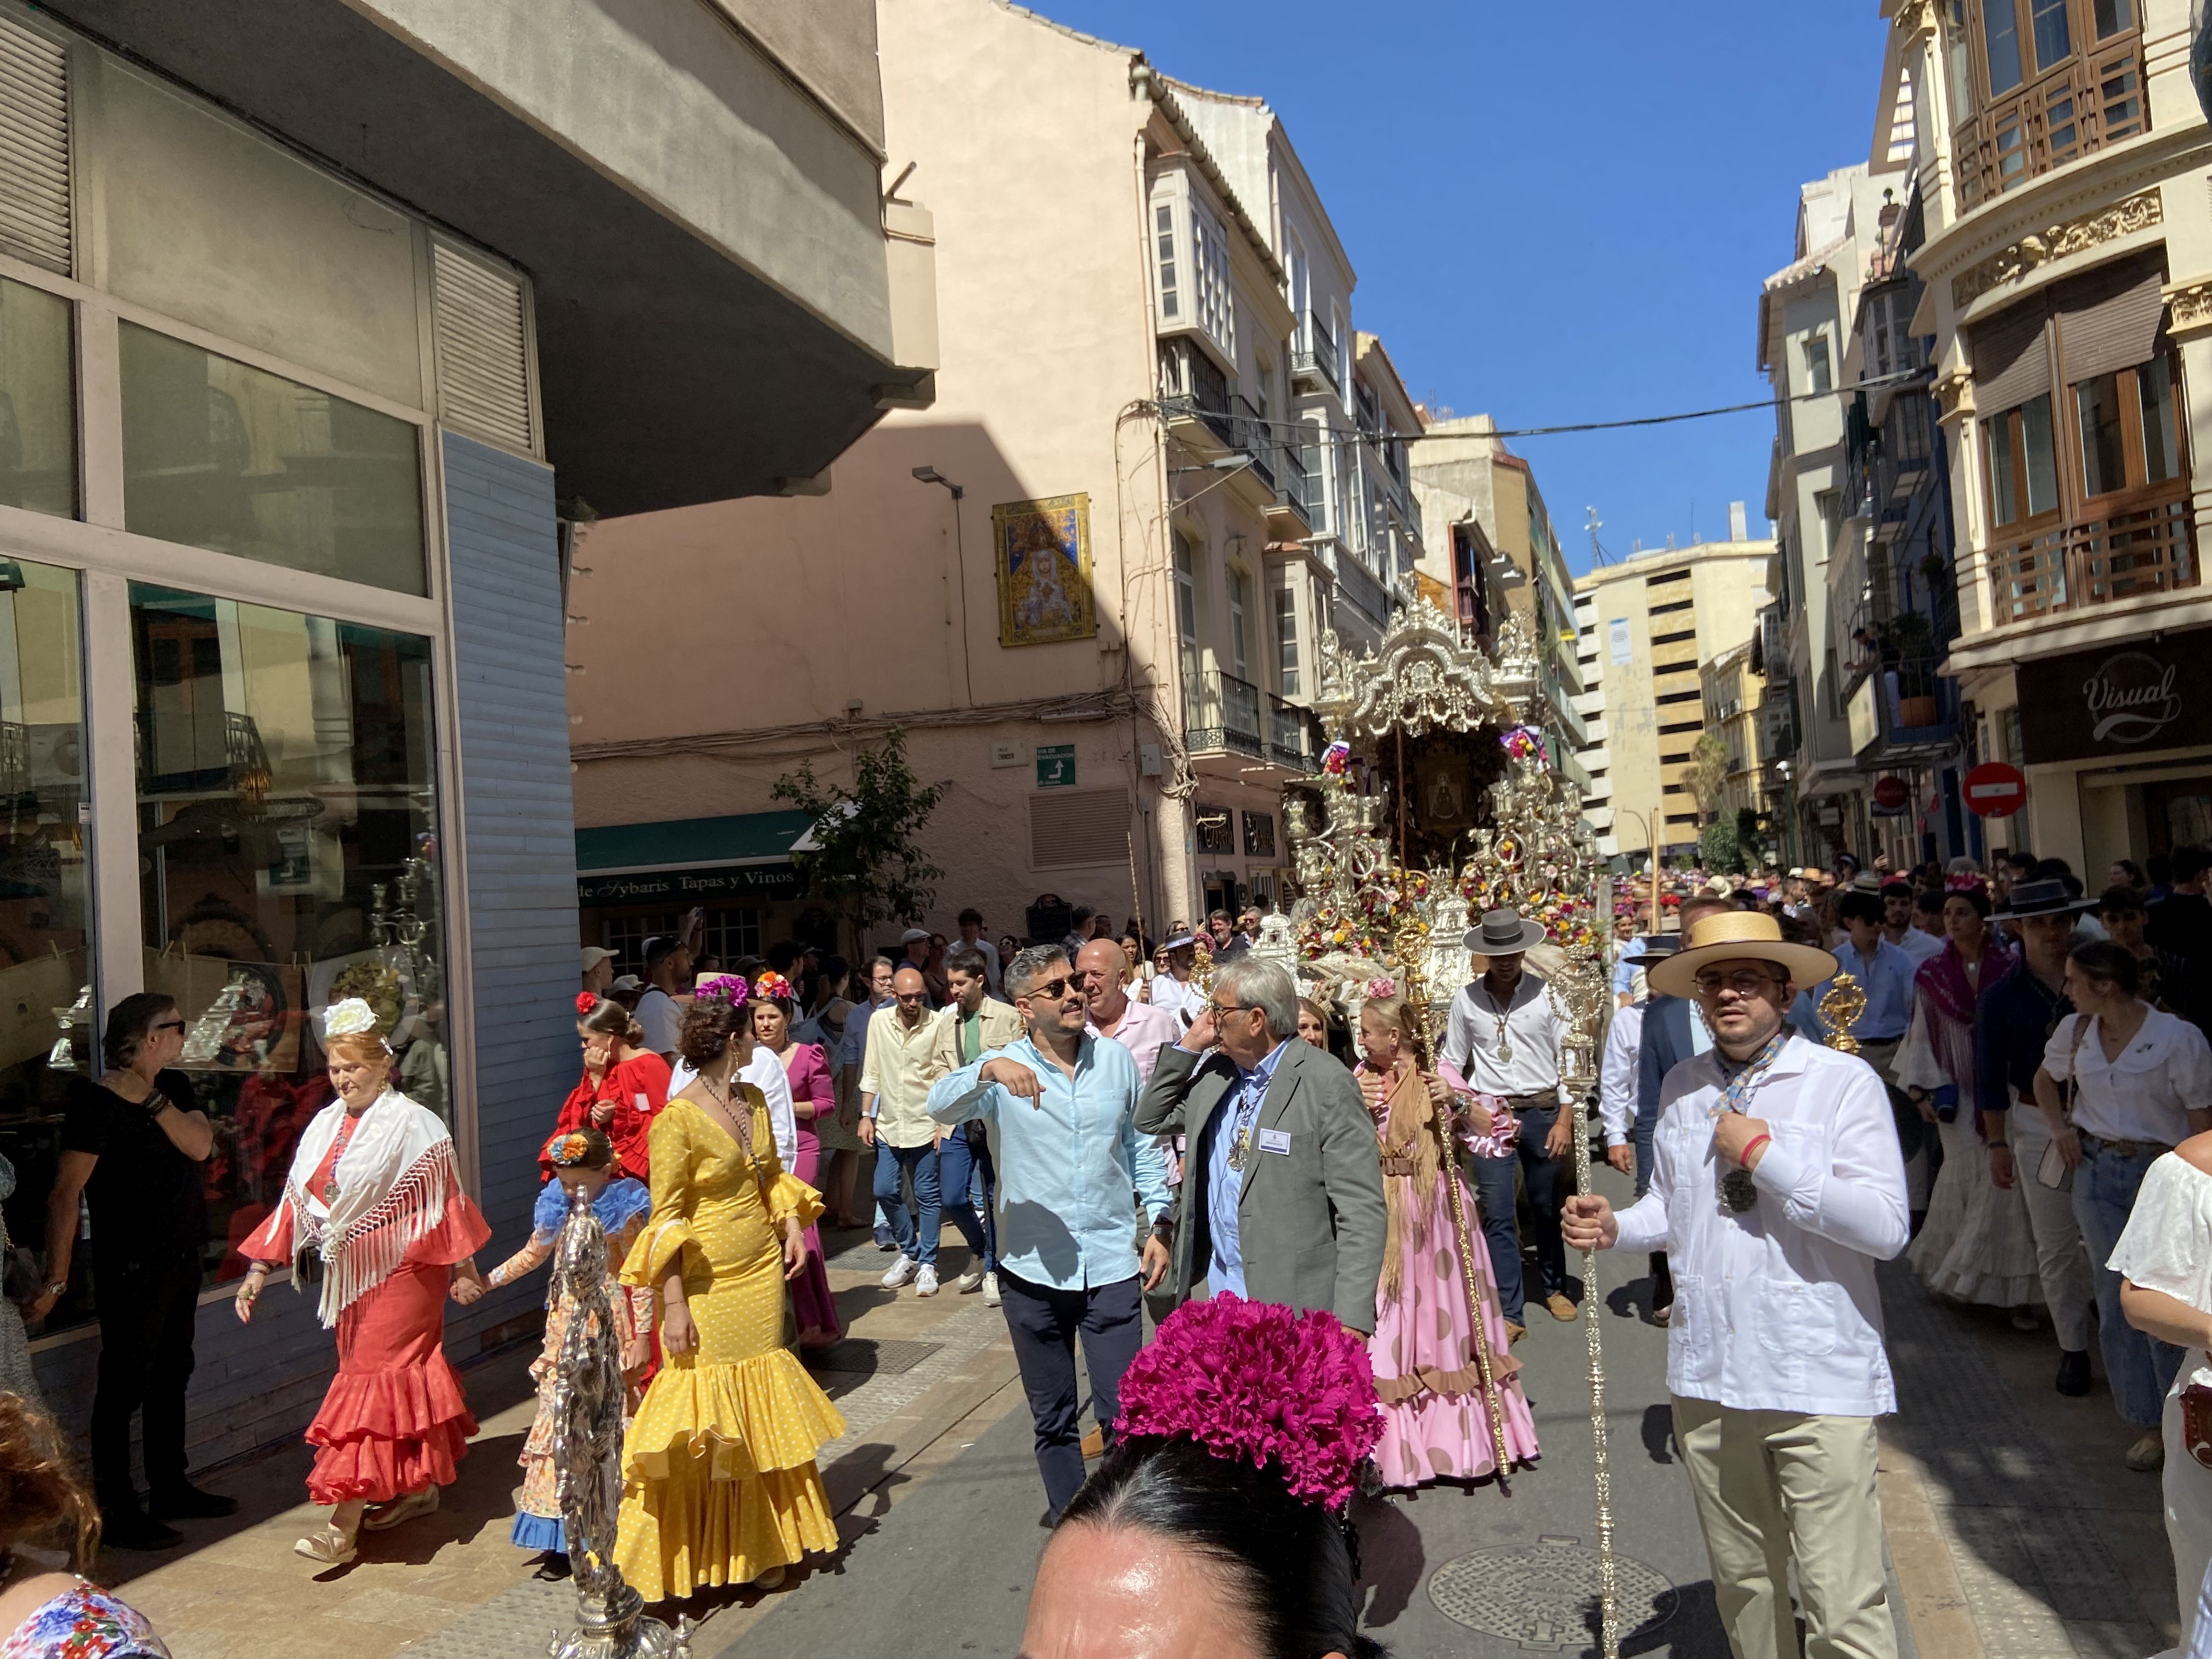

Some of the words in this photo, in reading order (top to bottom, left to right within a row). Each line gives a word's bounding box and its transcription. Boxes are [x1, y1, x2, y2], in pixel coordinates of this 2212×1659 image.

[2083, 663, 2176, 711] Visual
[597, 879, 670, 899] Sybaris
[678, 876, 725, 891] Tapas
[729, 877, 741, 889] y
[744, 871, 794, 885] Vinos
